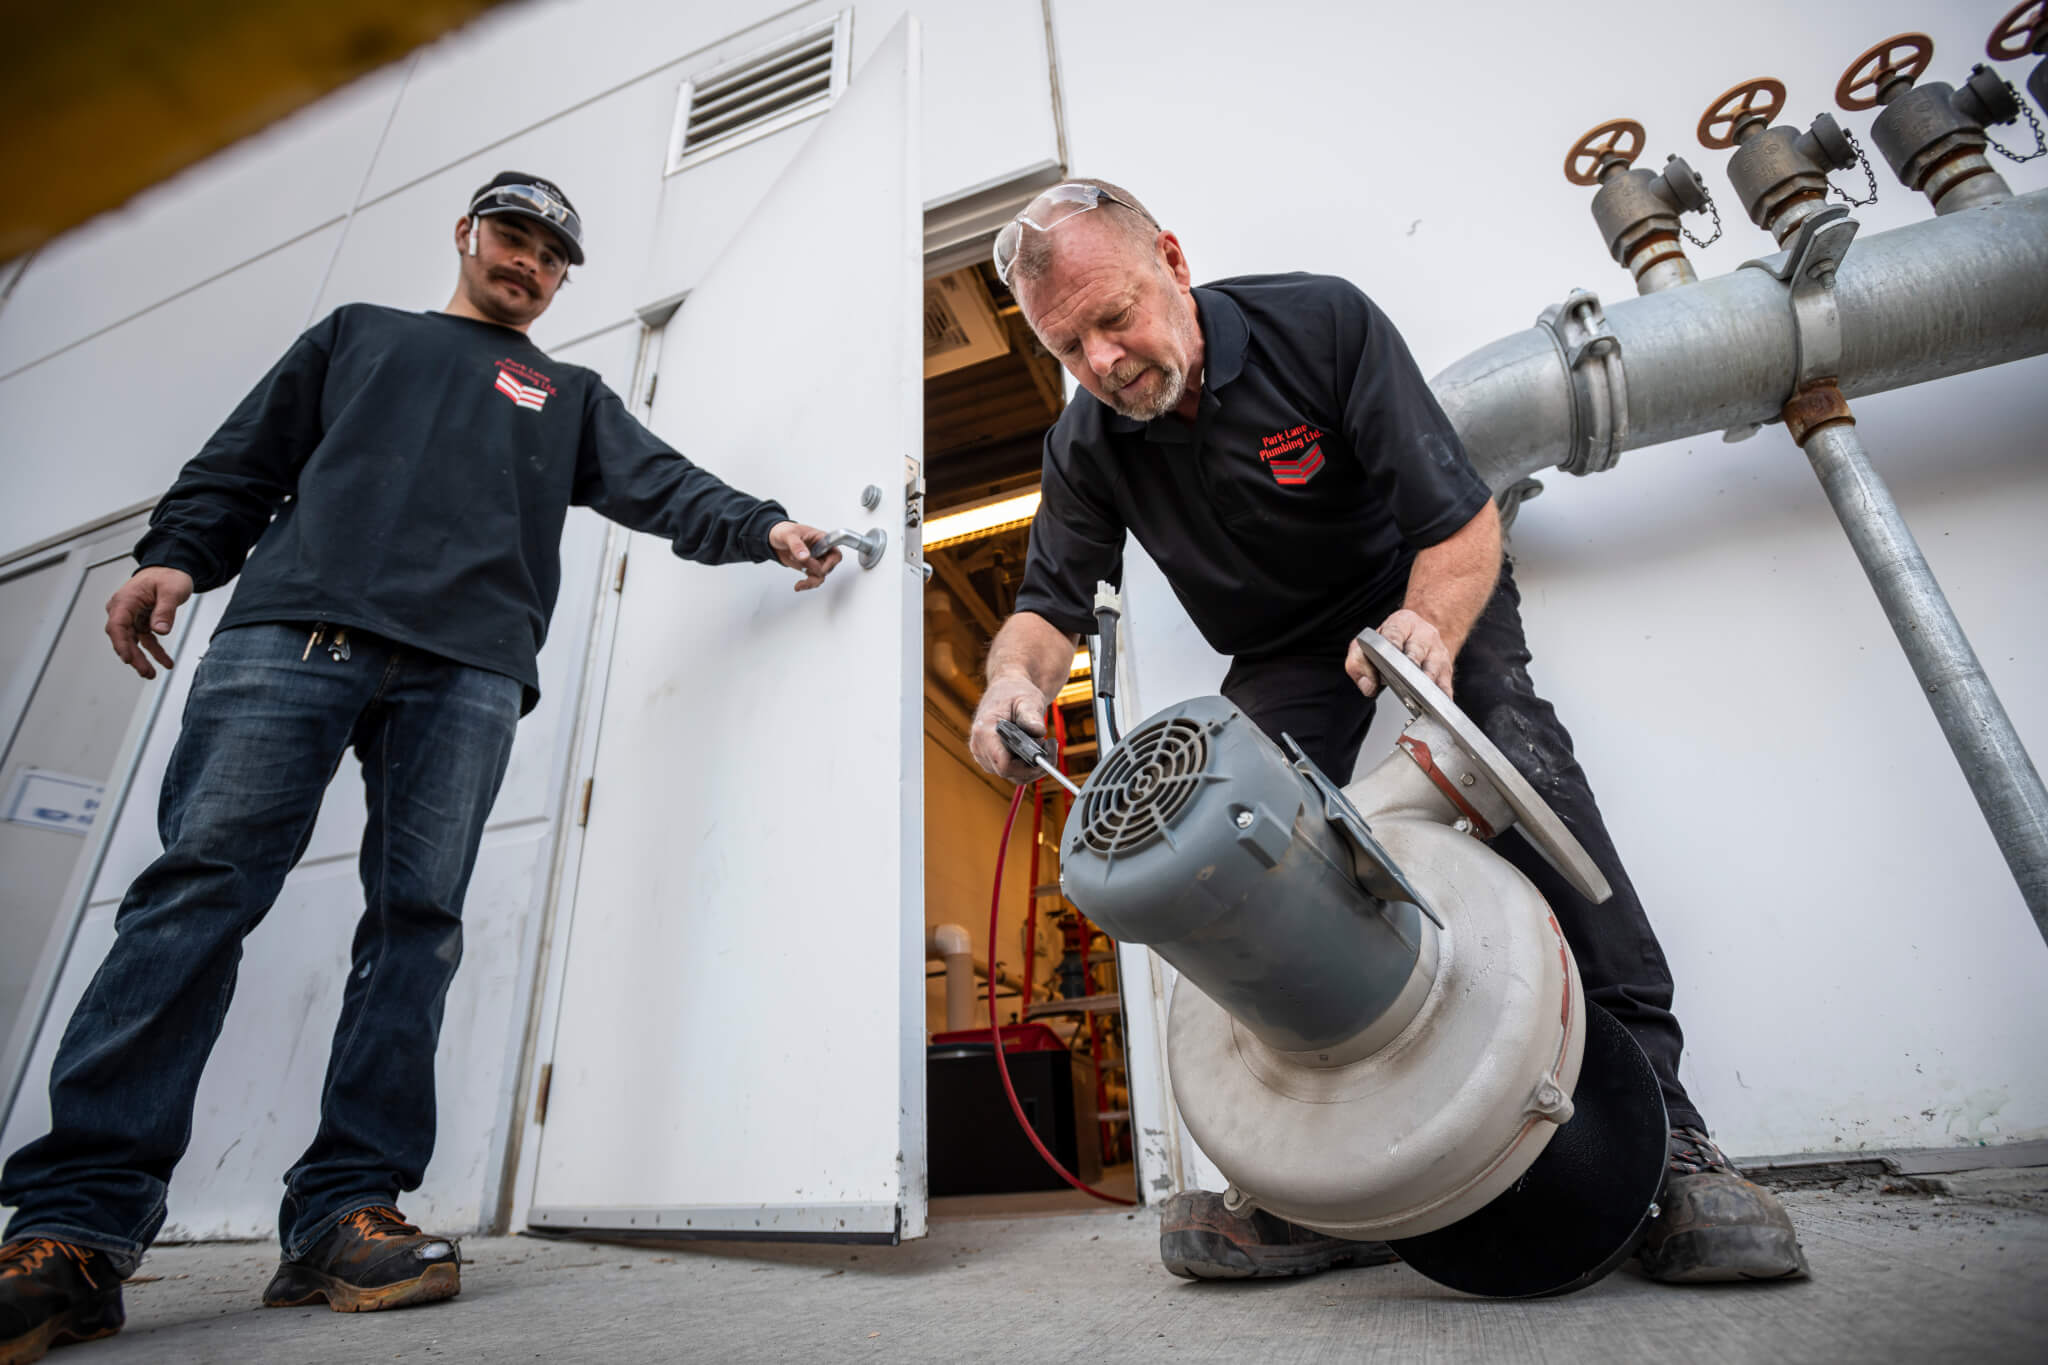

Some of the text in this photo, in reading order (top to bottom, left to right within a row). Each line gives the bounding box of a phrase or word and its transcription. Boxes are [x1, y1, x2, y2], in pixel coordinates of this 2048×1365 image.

[1262, 424, 1307, 447] Park Lane
[1259, 438, 1304, 462] Plumbing
